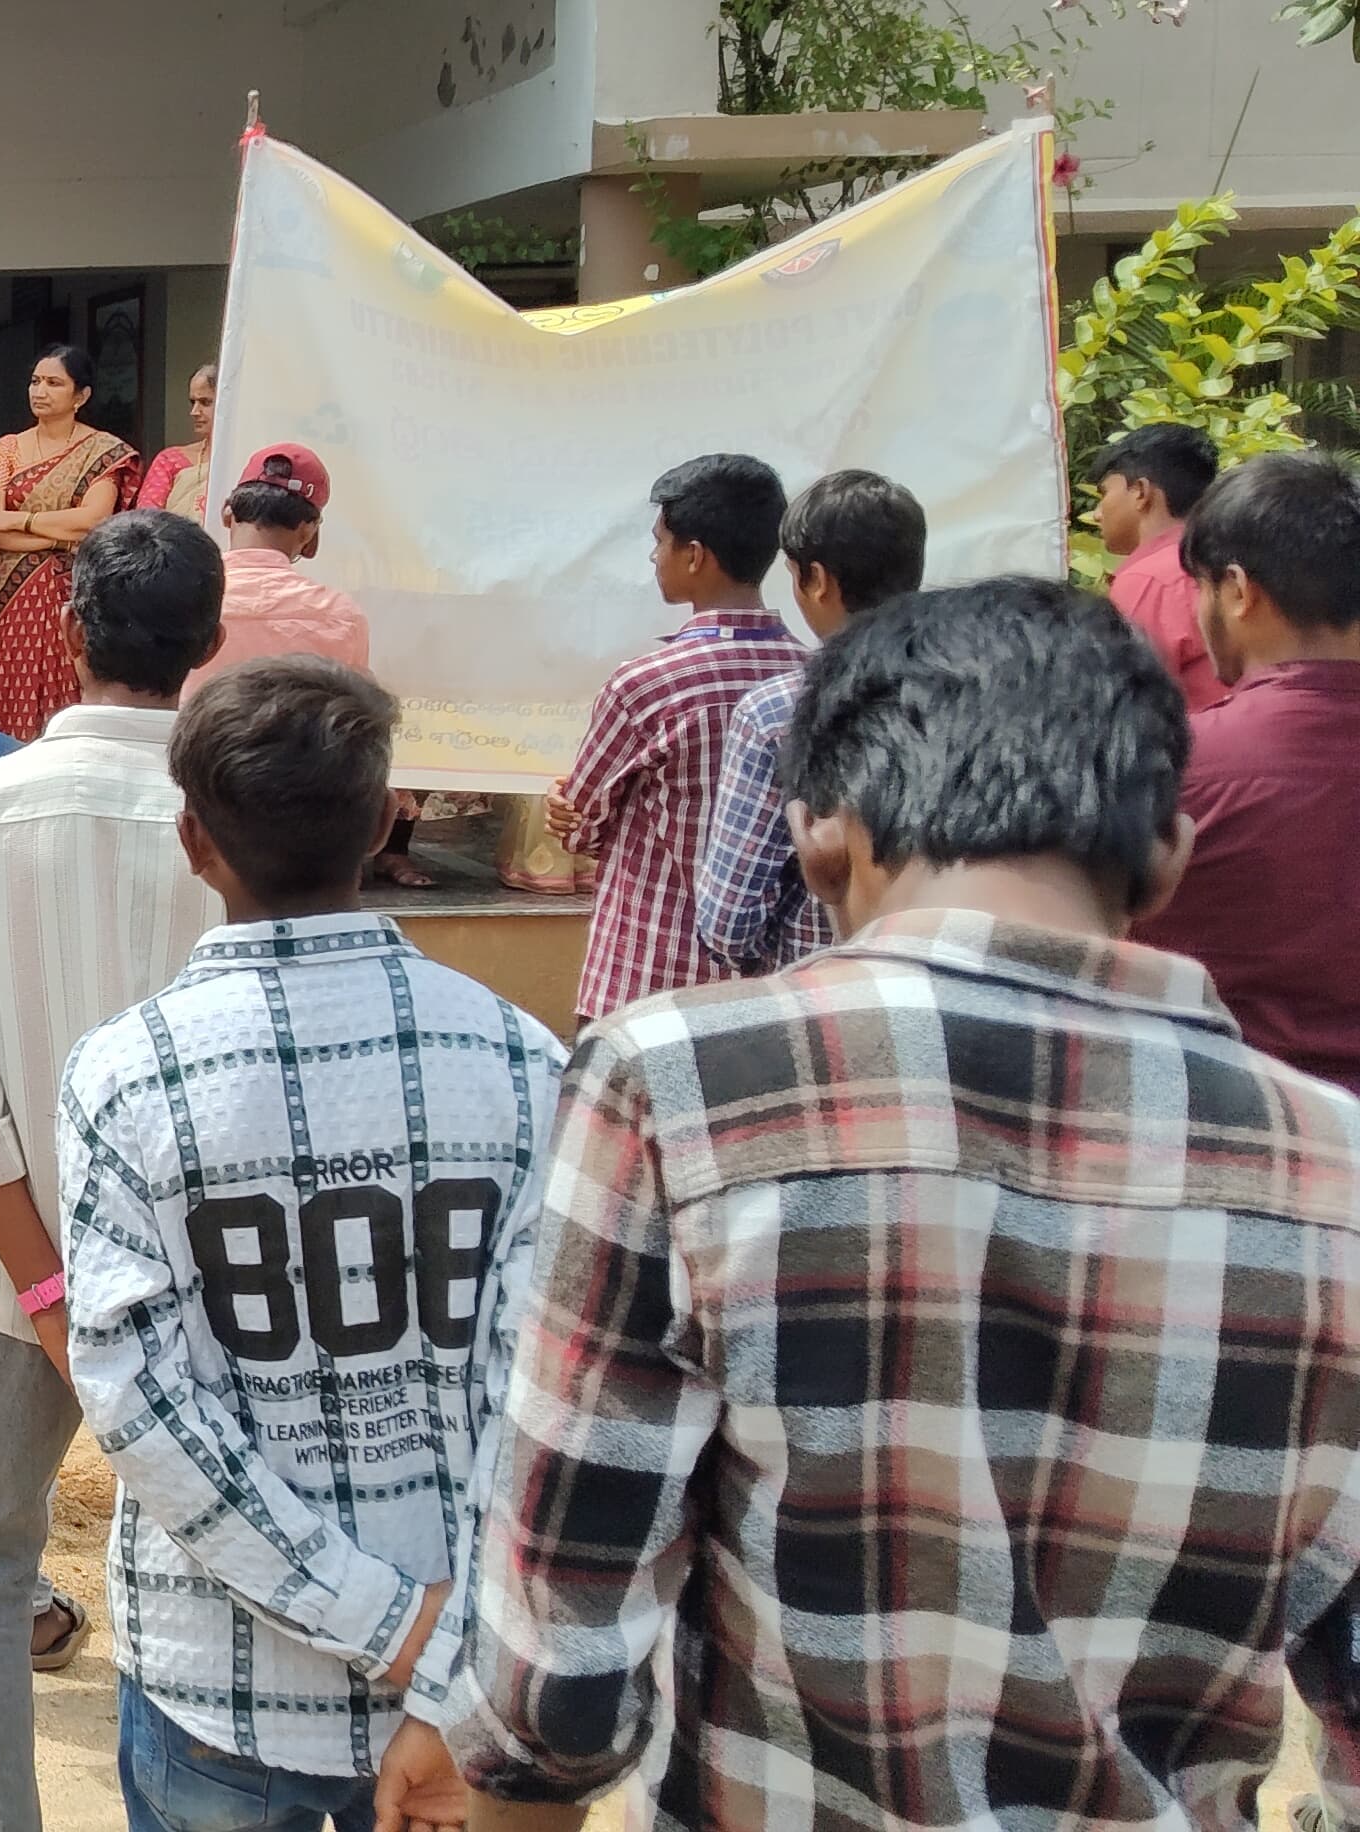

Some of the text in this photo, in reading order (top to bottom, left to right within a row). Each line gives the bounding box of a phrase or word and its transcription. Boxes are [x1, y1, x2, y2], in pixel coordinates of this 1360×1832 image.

[294, 1153, 397, 1188] RROR
[185, 1177, 502, 1361] 808
[322, 1386, 409, 1416] PERIENCE
[344, 1422, 360, 1440] IS
[365, 1408, 418, 1440] BETTER
